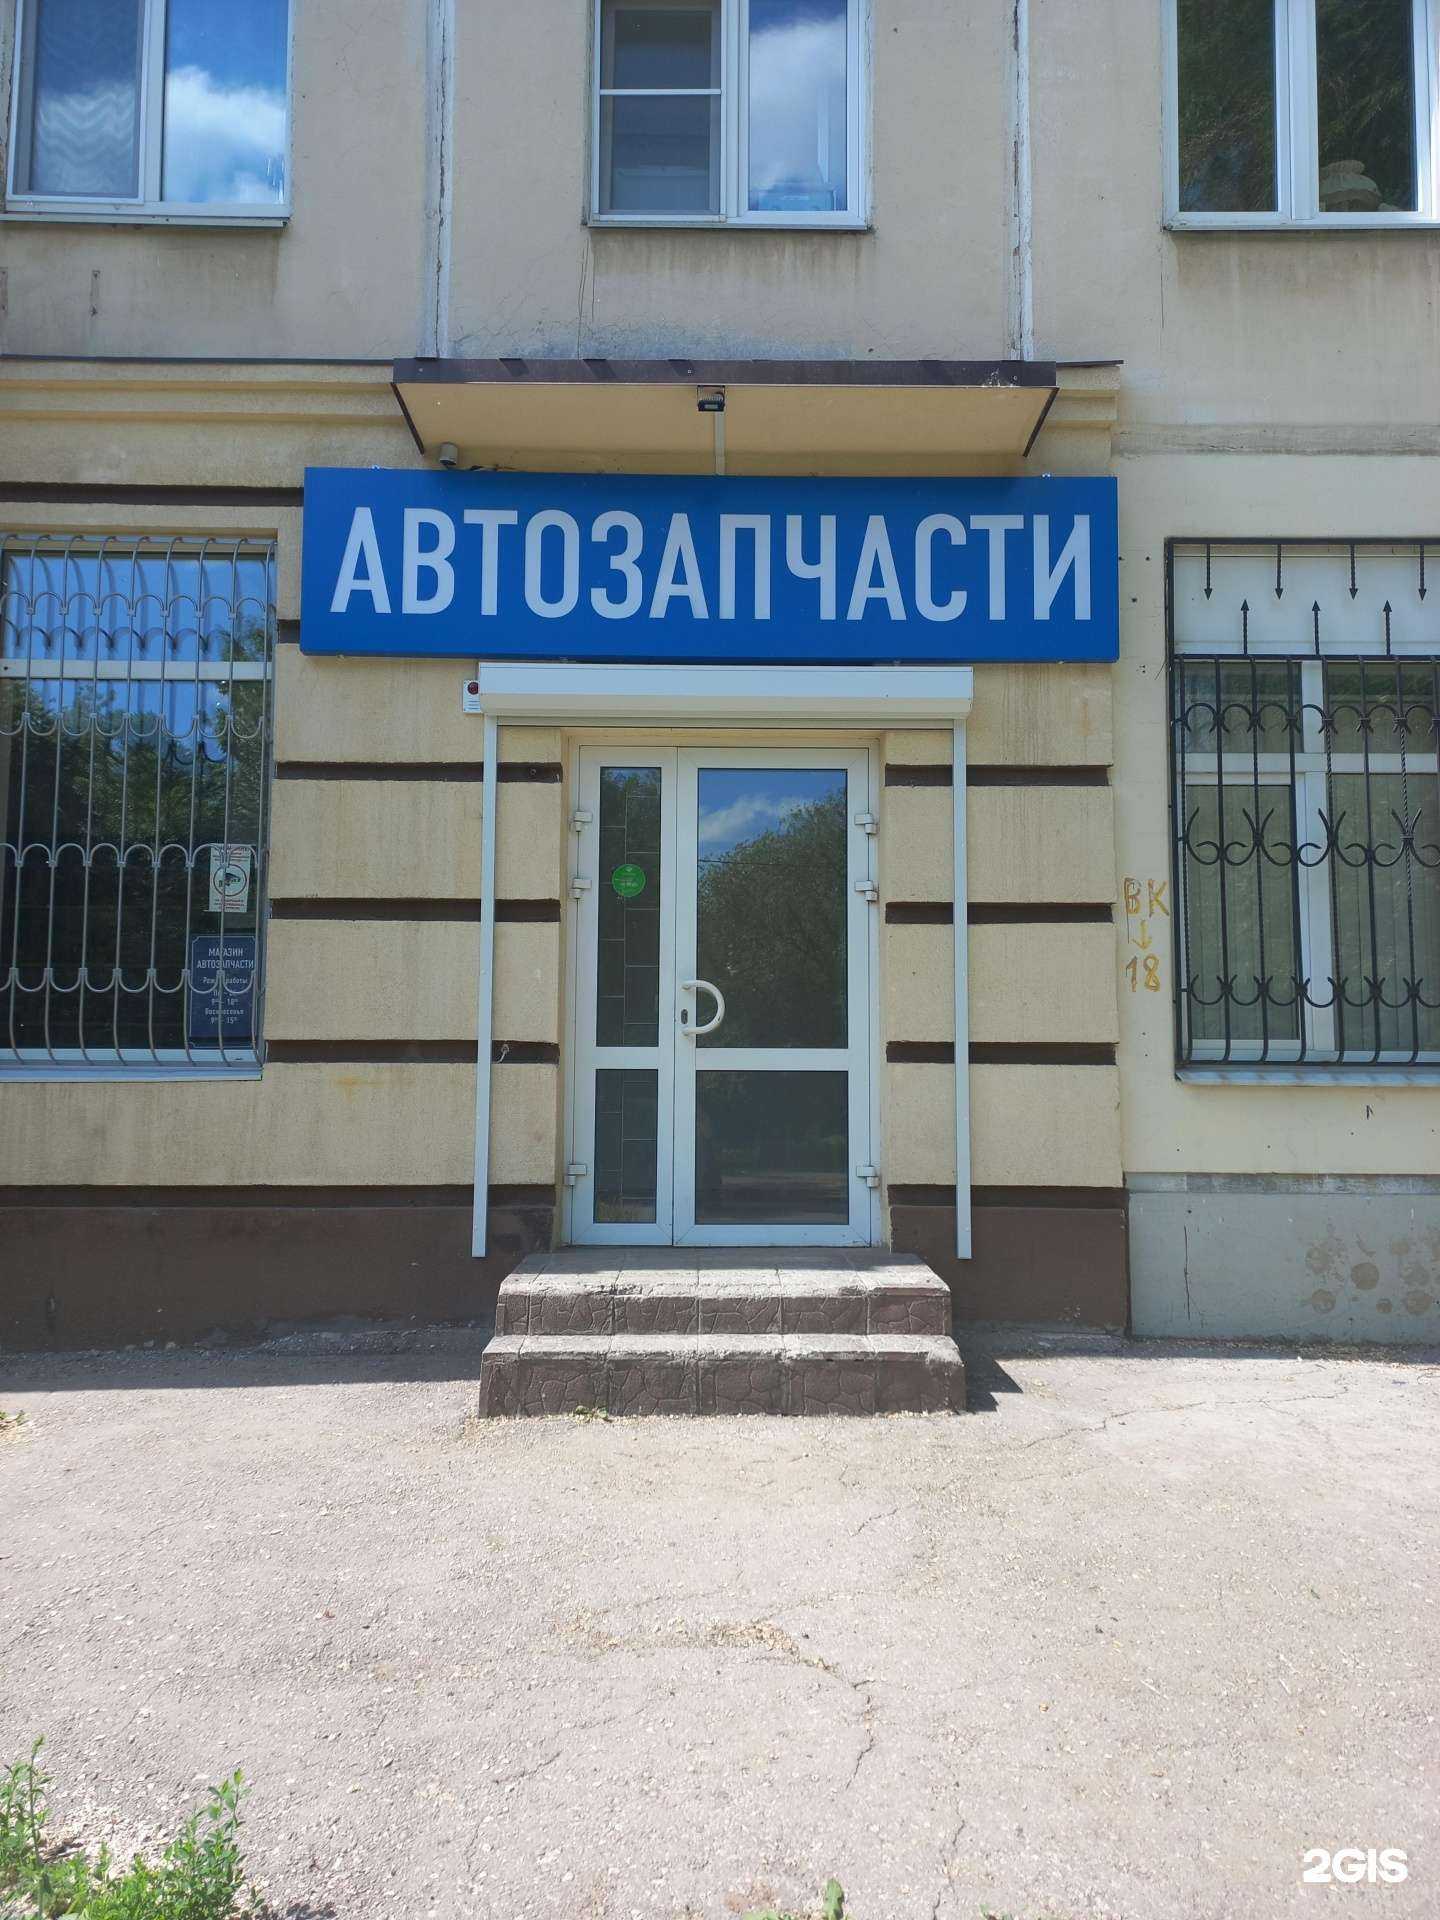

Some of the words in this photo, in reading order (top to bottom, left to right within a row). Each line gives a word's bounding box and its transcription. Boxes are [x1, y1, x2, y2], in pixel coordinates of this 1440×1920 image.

[330, 506, 1091, 622] АВТОЗАПЧАСТИ
[208, 948, 244, 957] МААЗИН
[1125, 953, 1160, 992] 18
